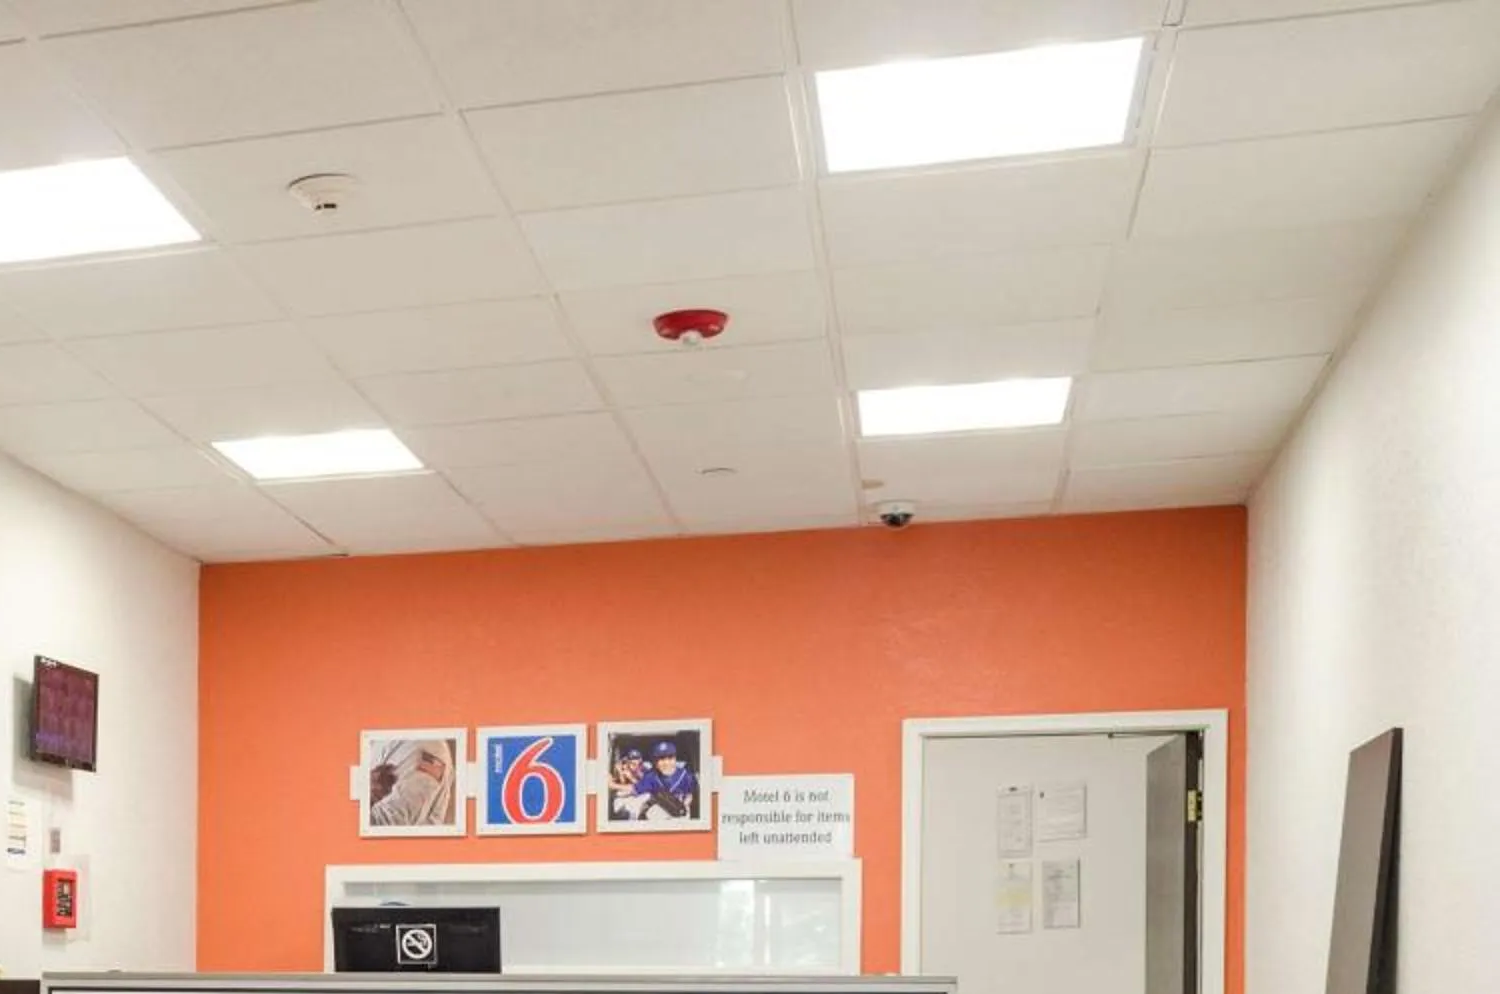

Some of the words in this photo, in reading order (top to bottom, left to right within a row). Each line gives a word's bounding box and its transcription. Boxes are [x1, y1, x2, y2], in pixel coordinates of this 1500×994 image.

[502, 737, 566, 824] 6
[743, 789, 779, 803] Motel
[783, 790, 792, 802] 6
[795, 790, 805, 802] is
[808, 789, 829, 802] not
[721, 810, 793, 827] responsible
[795, 809, 814, 823] for
[817, 809, 851, 823] items
[739, 831, 759, 844] left
[763, 831, 833, 845] unattended
